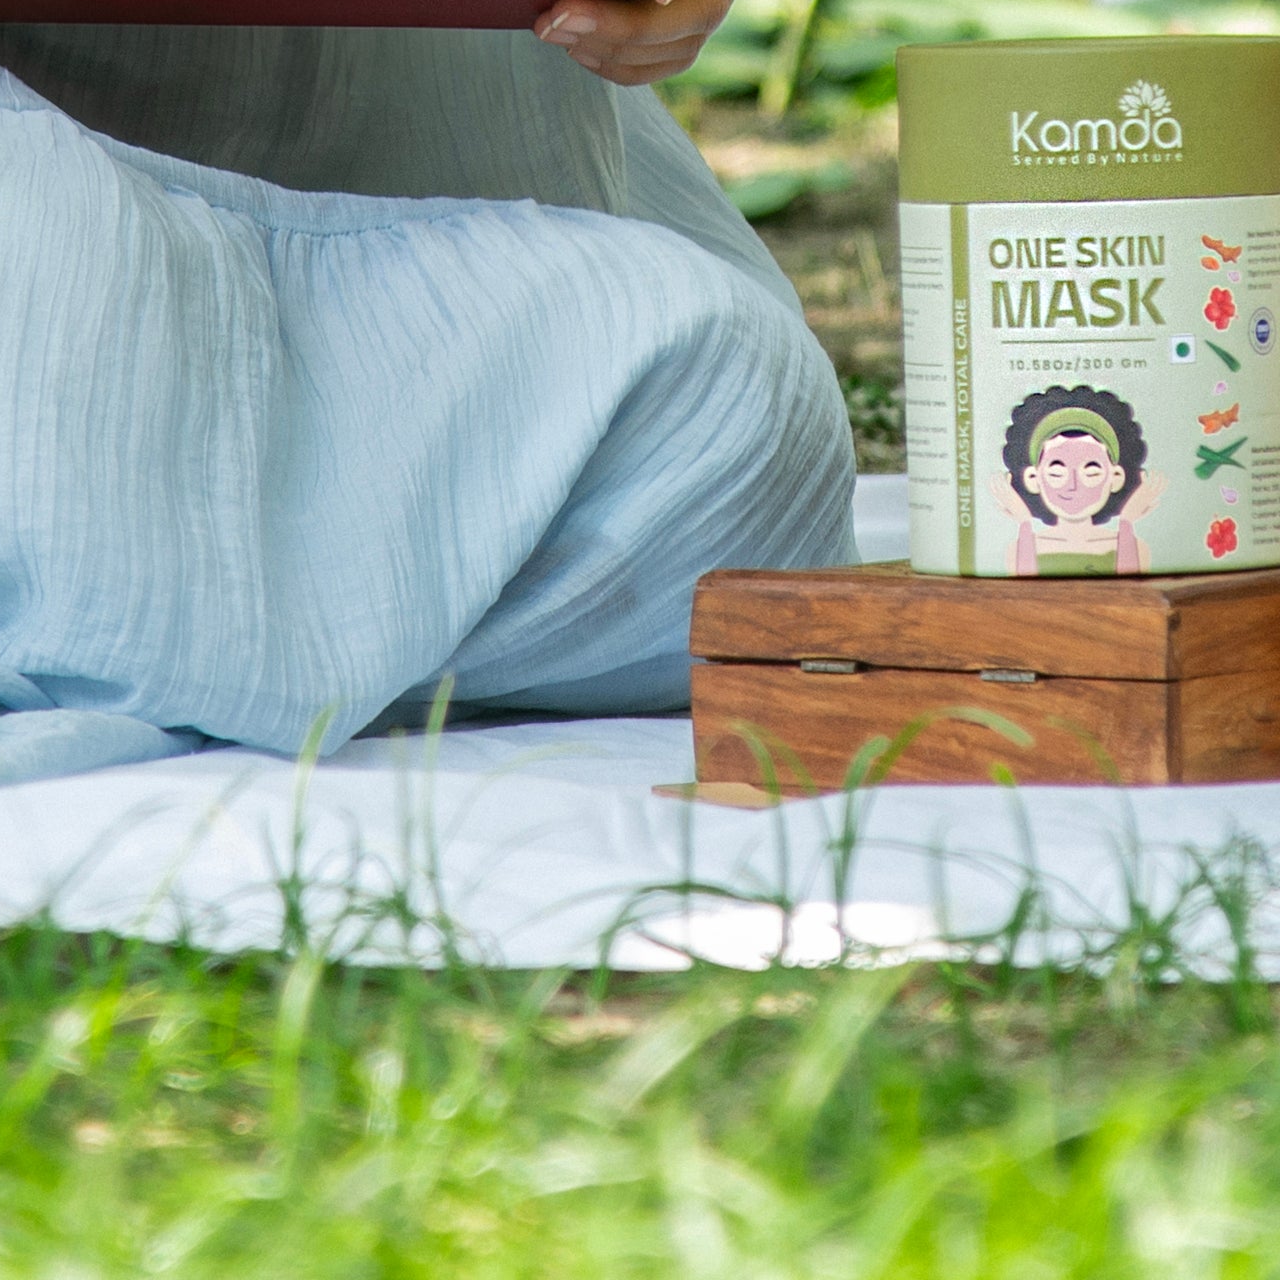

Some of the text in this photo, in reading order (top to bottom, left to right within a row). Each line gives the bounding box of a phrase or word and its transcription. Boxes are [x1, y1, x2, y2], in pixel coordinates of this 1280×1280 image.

[1012, 109, 1183, 152] Kamda
[1012, 152, 1183, 165] Served By Nature
[988, 235, 1166, 269] ONE SKIN
[955, 298, 968, 350] CARE
[991, 277, 1166, 329] MASK
[1121, 359, 1147, 368] Gm
[956, 355, 969, 416] TOTAL
[960, 486, 971, 528] ONE
